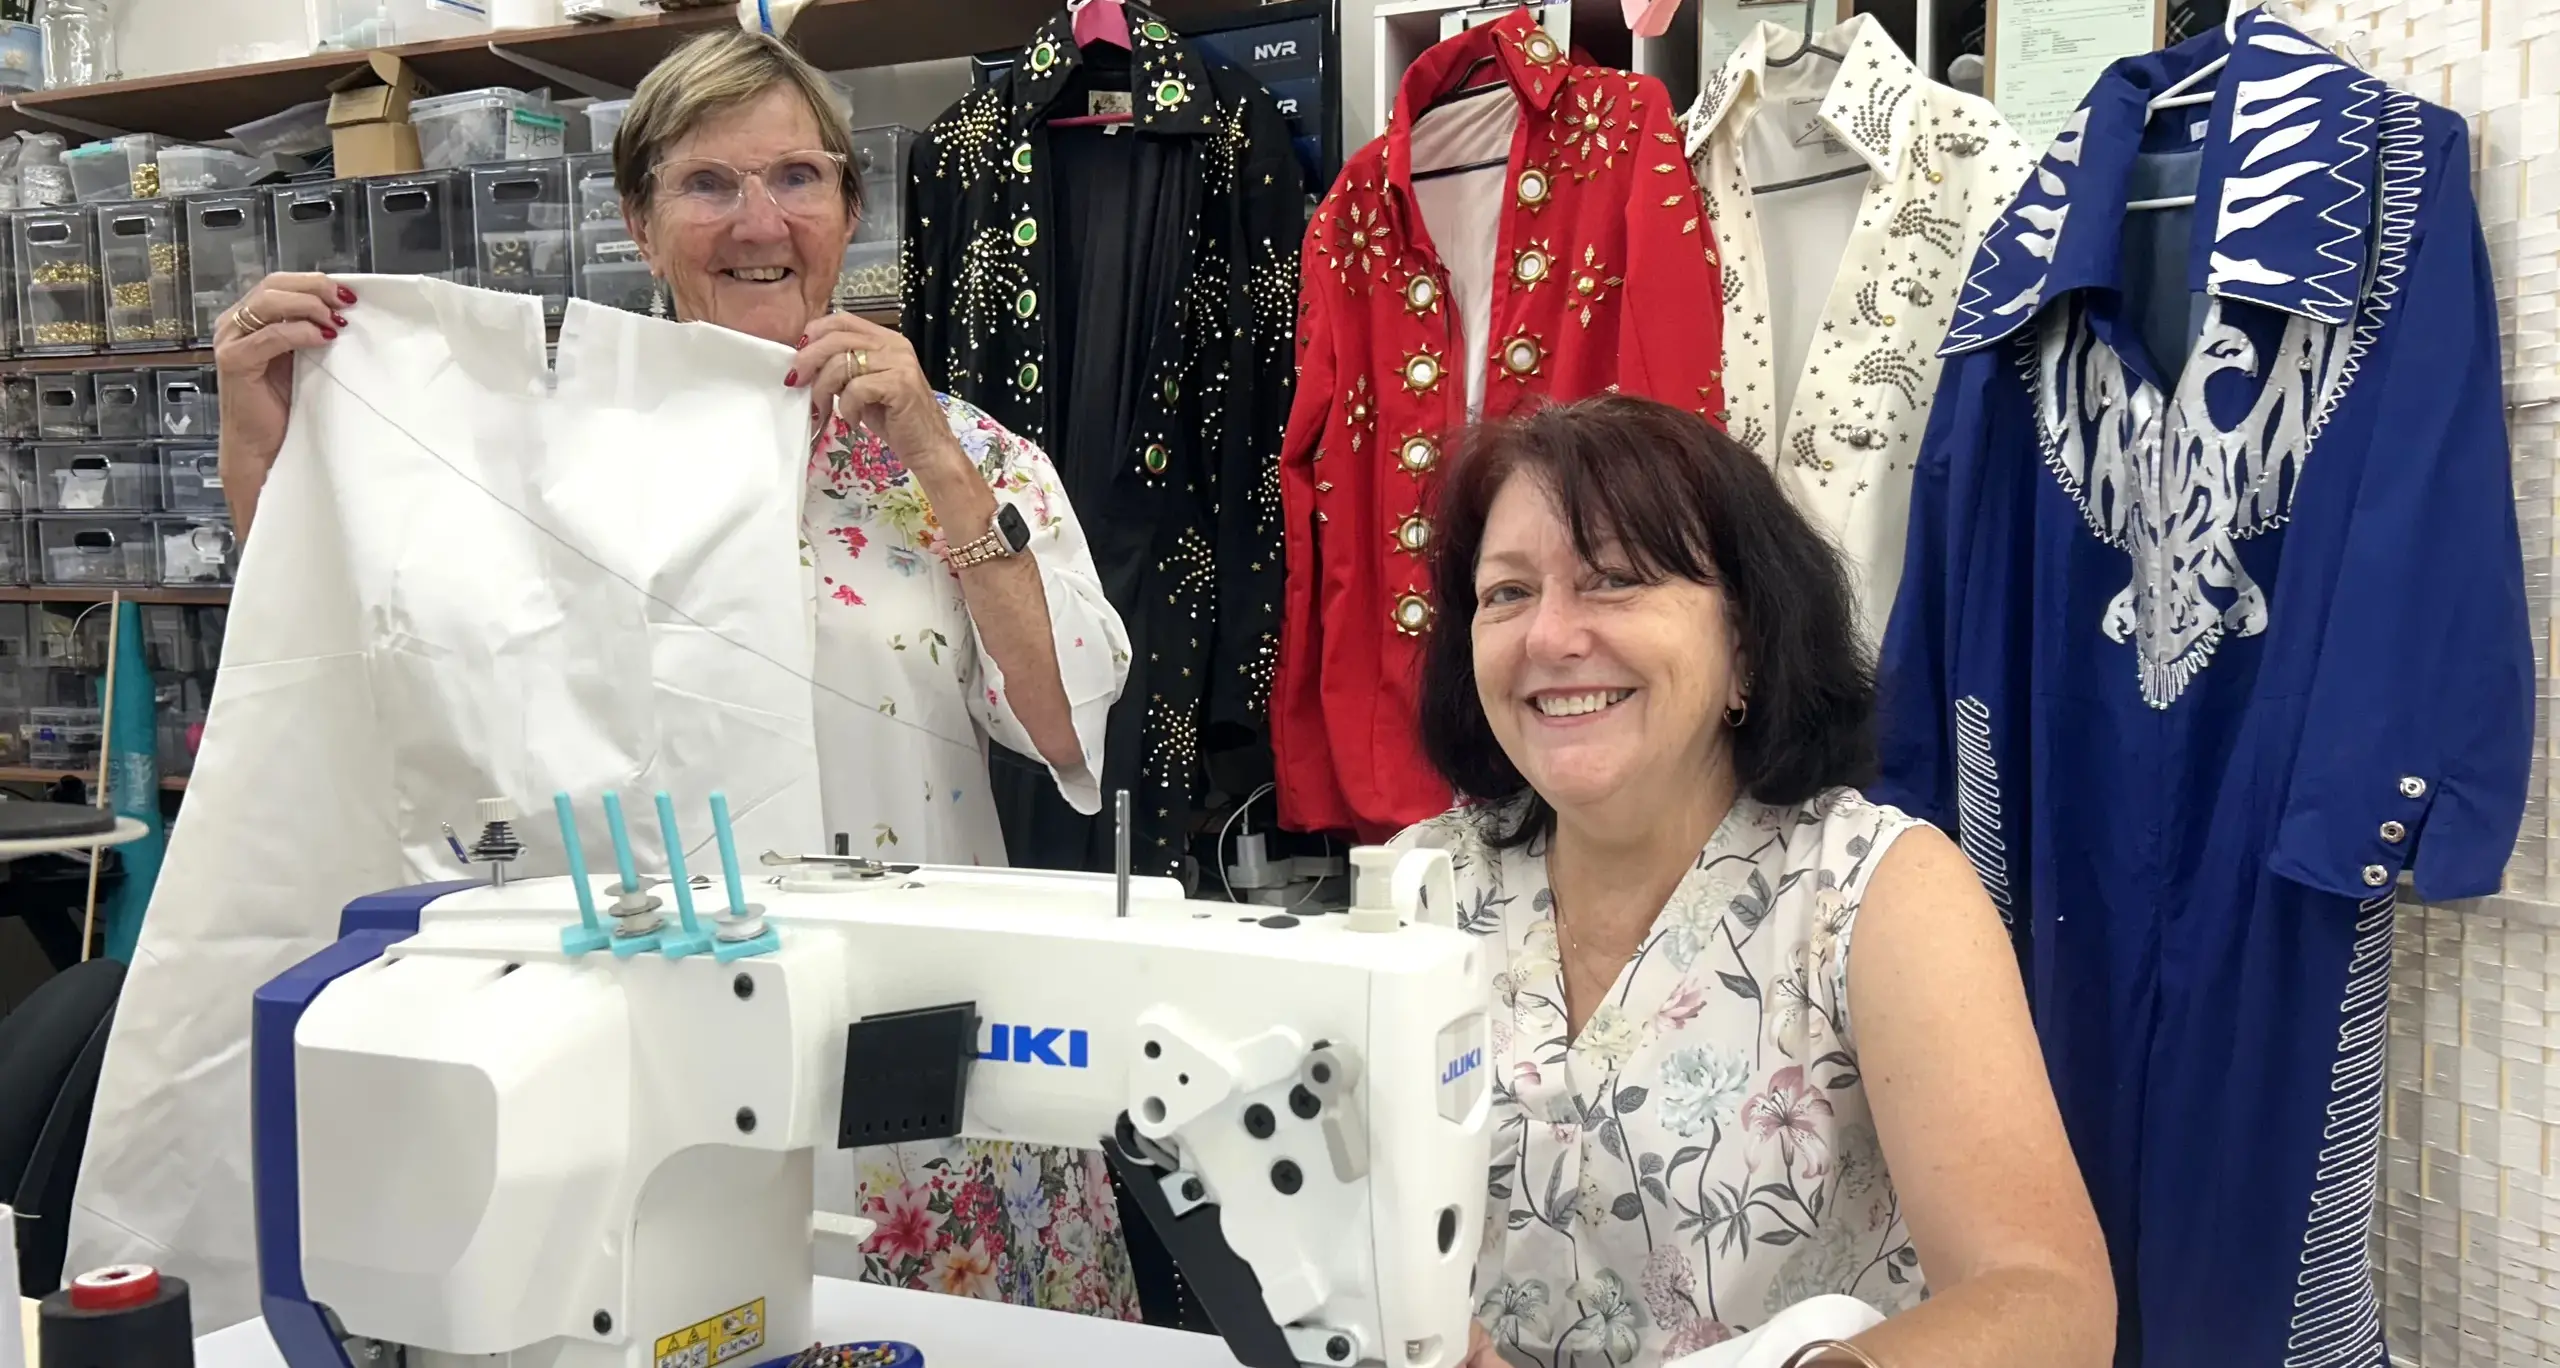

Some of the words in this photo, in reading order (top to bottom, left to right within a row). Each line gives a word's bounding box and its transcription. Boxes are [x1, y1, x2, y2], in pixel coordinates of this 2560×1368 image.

[1254, 40, 1297, 60] NVR
[977, 1023, 1088, 1068] UKI
[1442, 1046, 1481, 1085] JUKI
